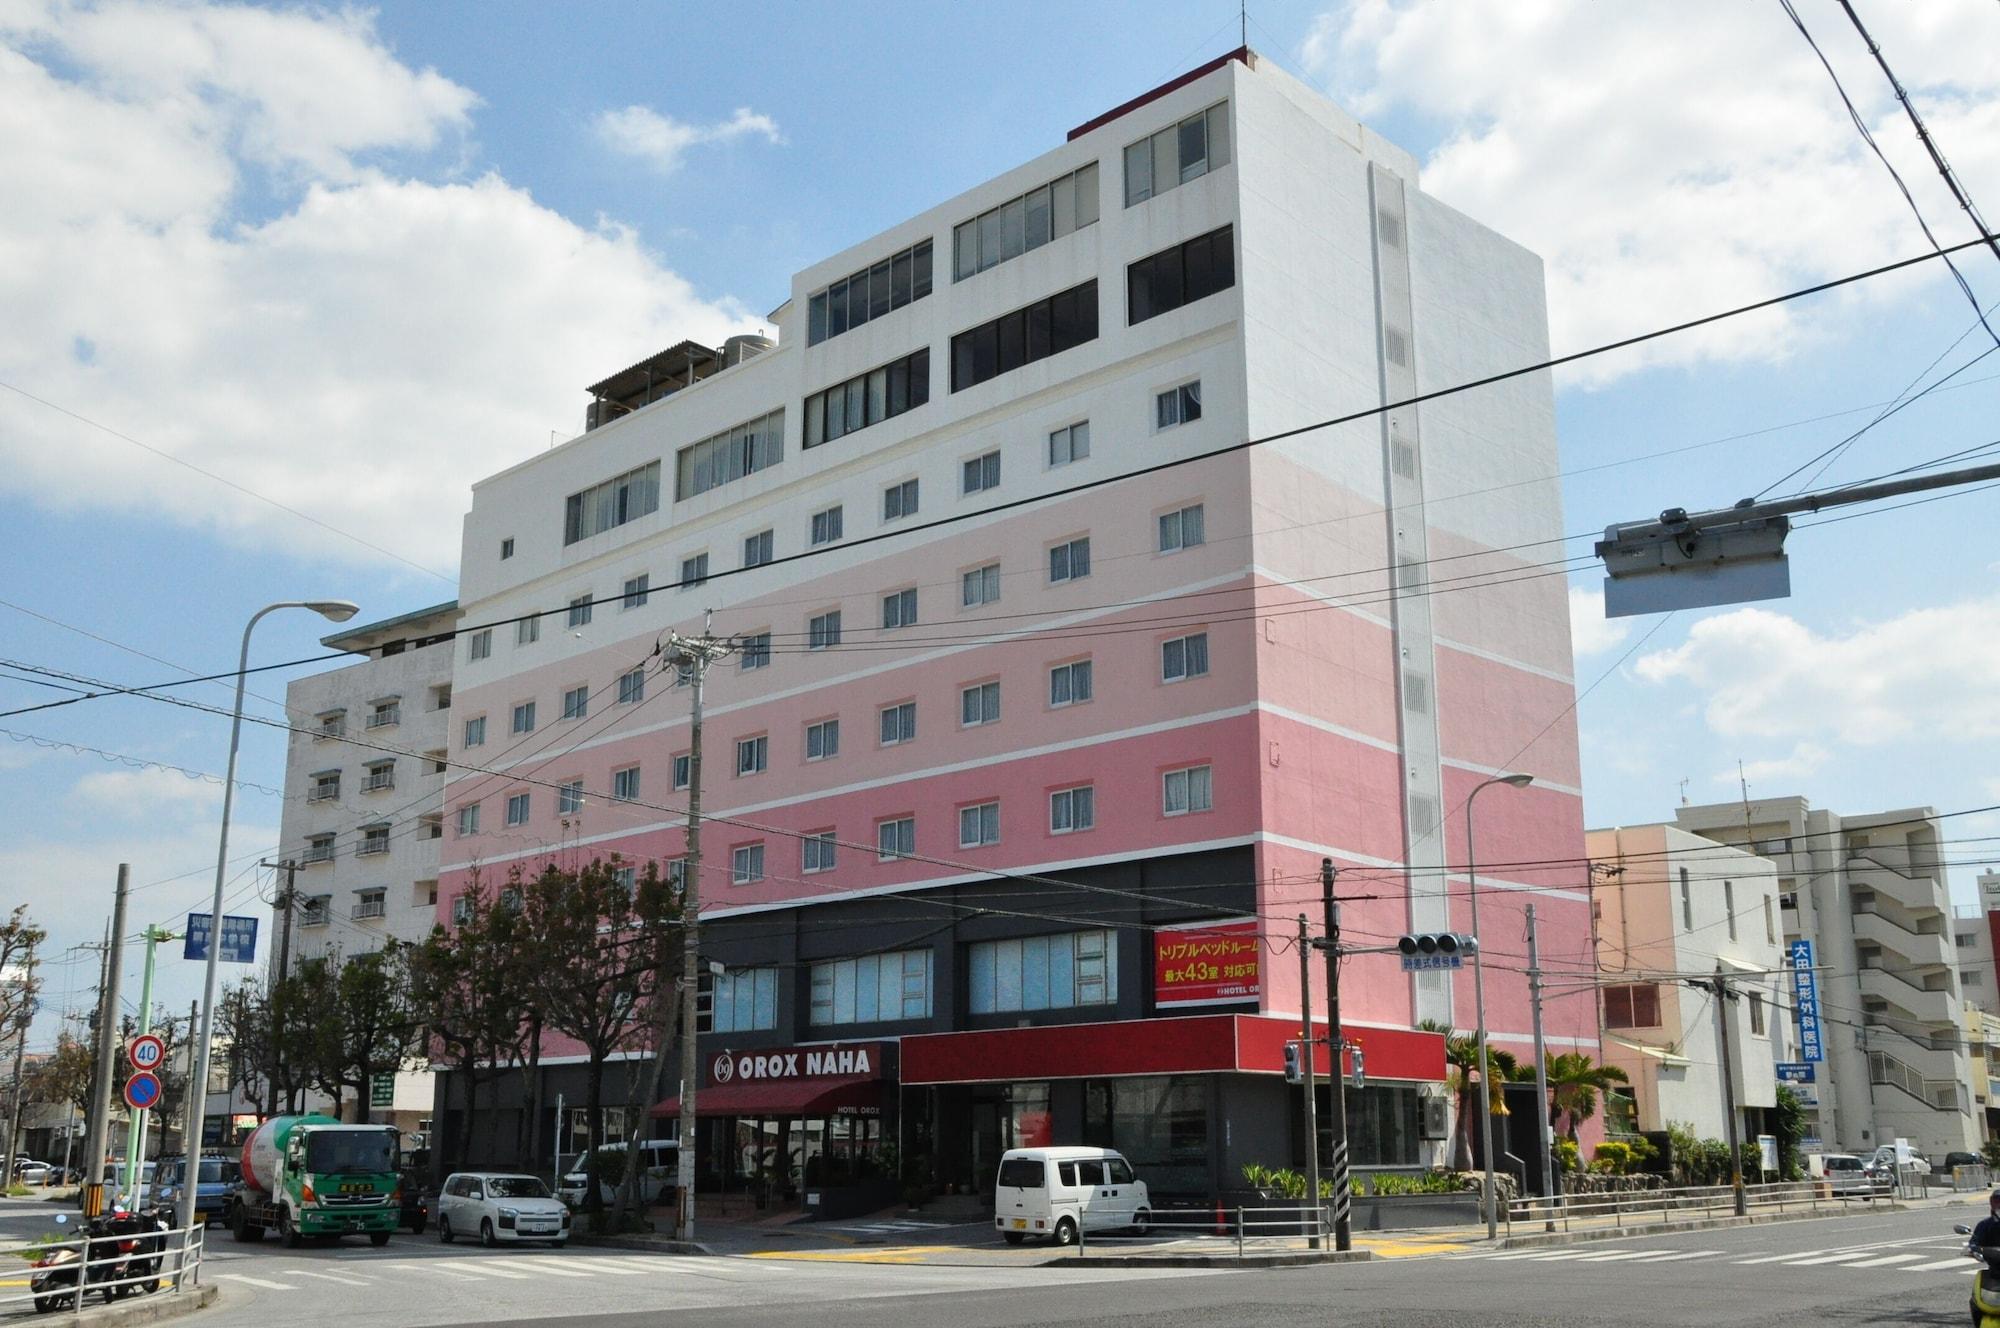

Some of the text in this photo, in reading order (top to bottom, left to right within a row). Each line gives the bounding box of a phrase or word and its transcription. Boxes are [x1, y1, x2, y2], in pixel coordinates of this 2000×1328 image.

[1404, 956, 1460, 969] 時差式信号機
[1165, 961, 1259, 982] 最大43室 対応可
[1223, 985, 1247, 995] HOTEL
[1794, 943, 1819, 1058] 大田整形外科医院
[137, 1044, 157, 1061] 40
[738, 1049, 871, 1080] OROX NAHA
[837, 1106, 858, 1115] HOTEL
